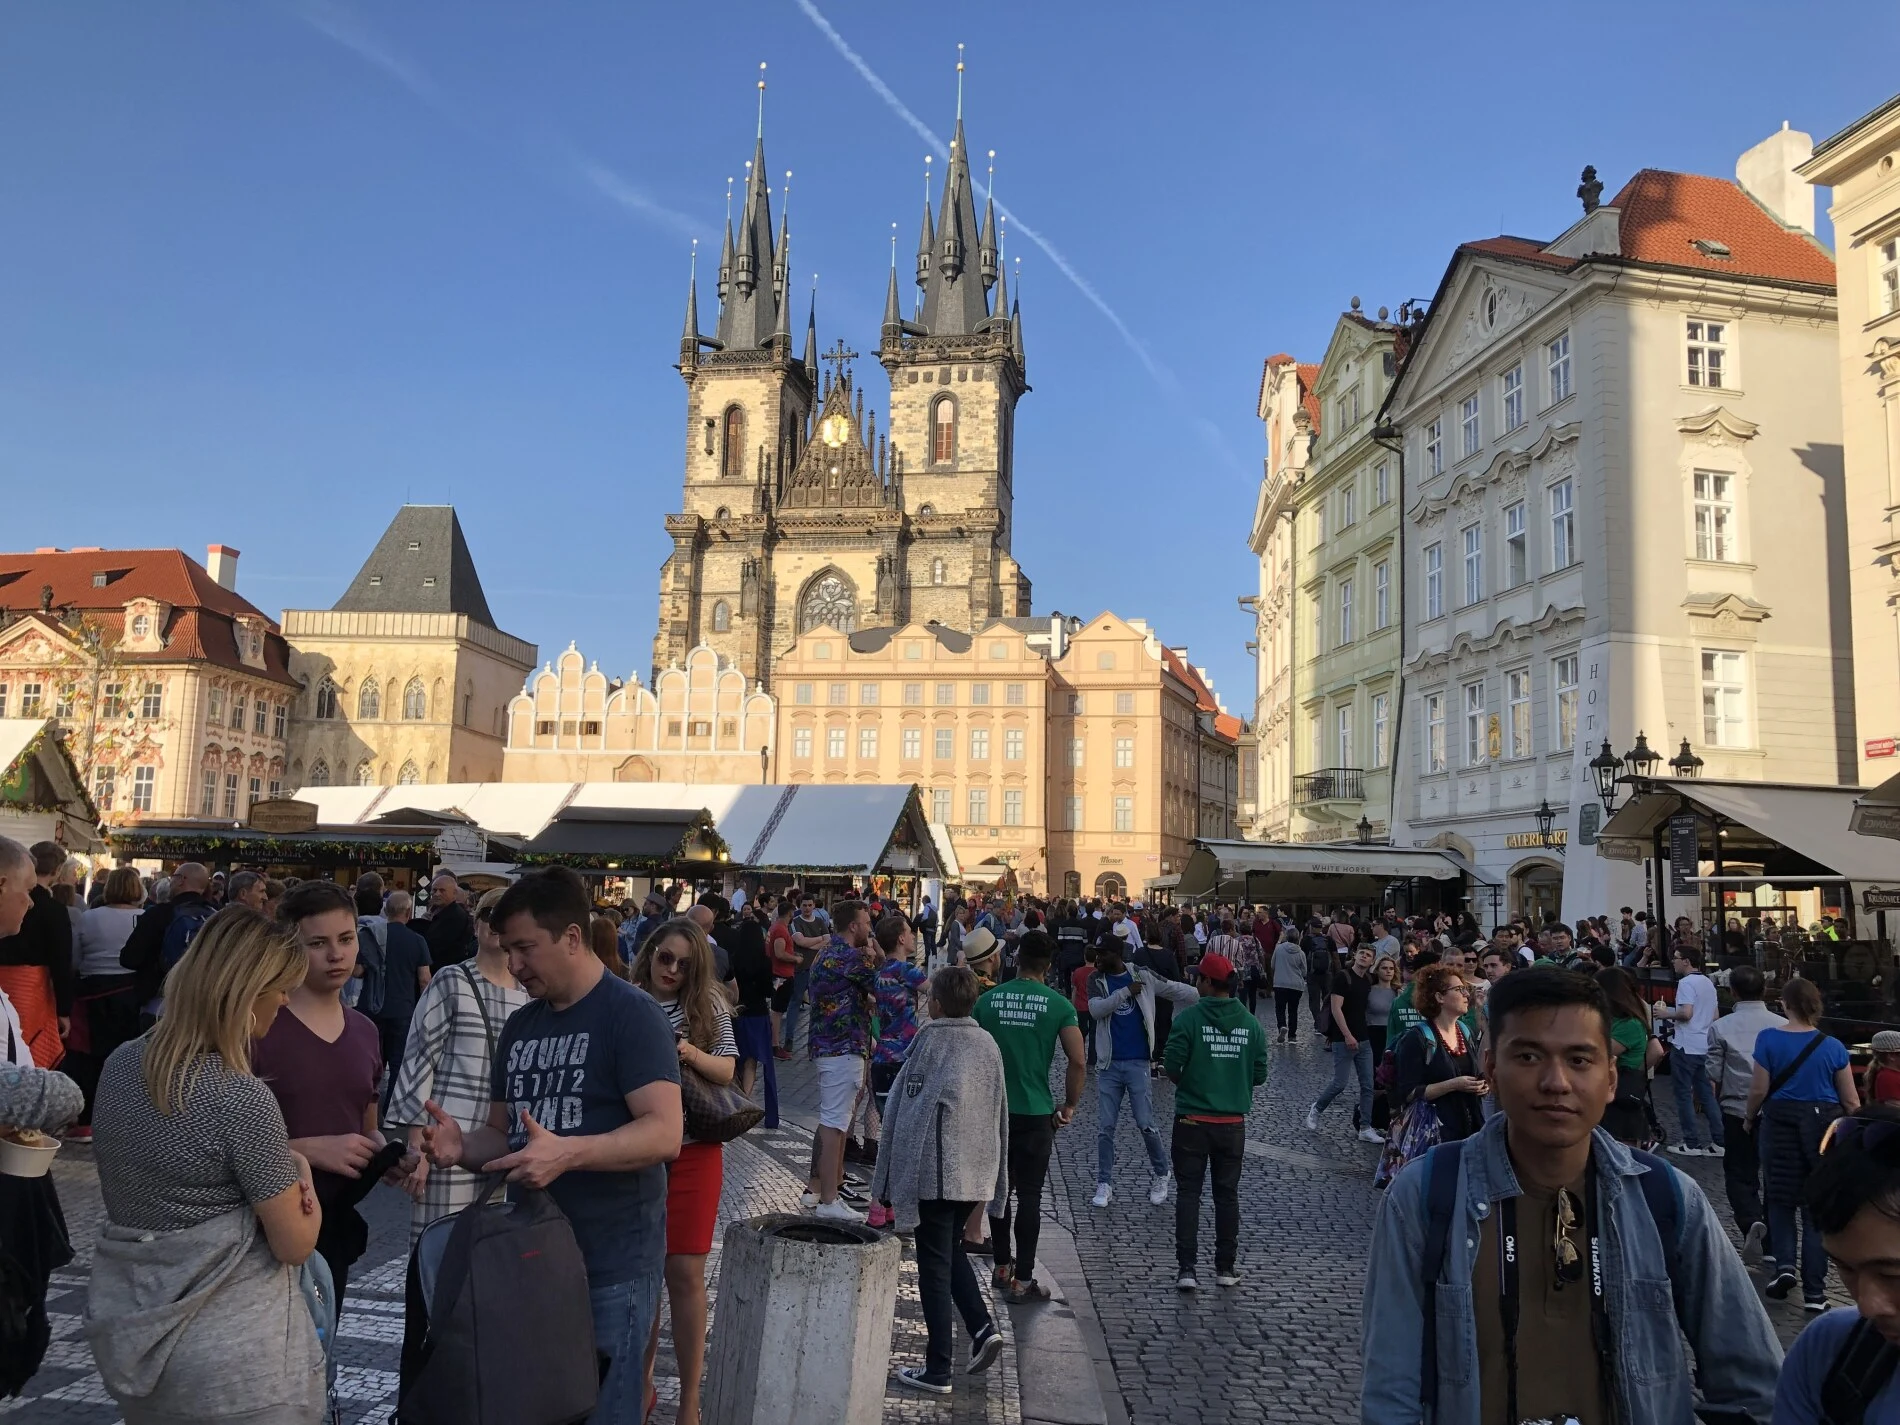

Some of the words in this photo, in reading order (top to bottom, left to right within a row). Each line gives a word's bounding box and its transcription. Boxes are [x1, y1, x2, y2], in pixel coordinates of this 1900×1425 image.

[1582, 663, 1598, 782] HOTEL
[1547, 830, 1568, 844] ART
[1311, 864, 1340, 872] WHITE
[1006, 992, 1025, 1000] BEST
[1026, 994, 1049, 1003] NIGHT
[990, 1000, 1004, 1008] YOU
[1006, 1001, 1023, 1009] WILL
[1025, 1002, 1048, 1012] NEVER
[998, 1009, 1037, 1020] REMEMBER
[1202, 1025, 1214, 1033] THE
[1216, 1035, 1228, 1043] WILL
[1230, 1036, 1248, 1044] NEVER
[507, 1032, 590, 1073] SOUND
[1210, 1044, 1240, 1052] REMEMBER
[1591, 1237, 1601, 1296] OLYMPUS
